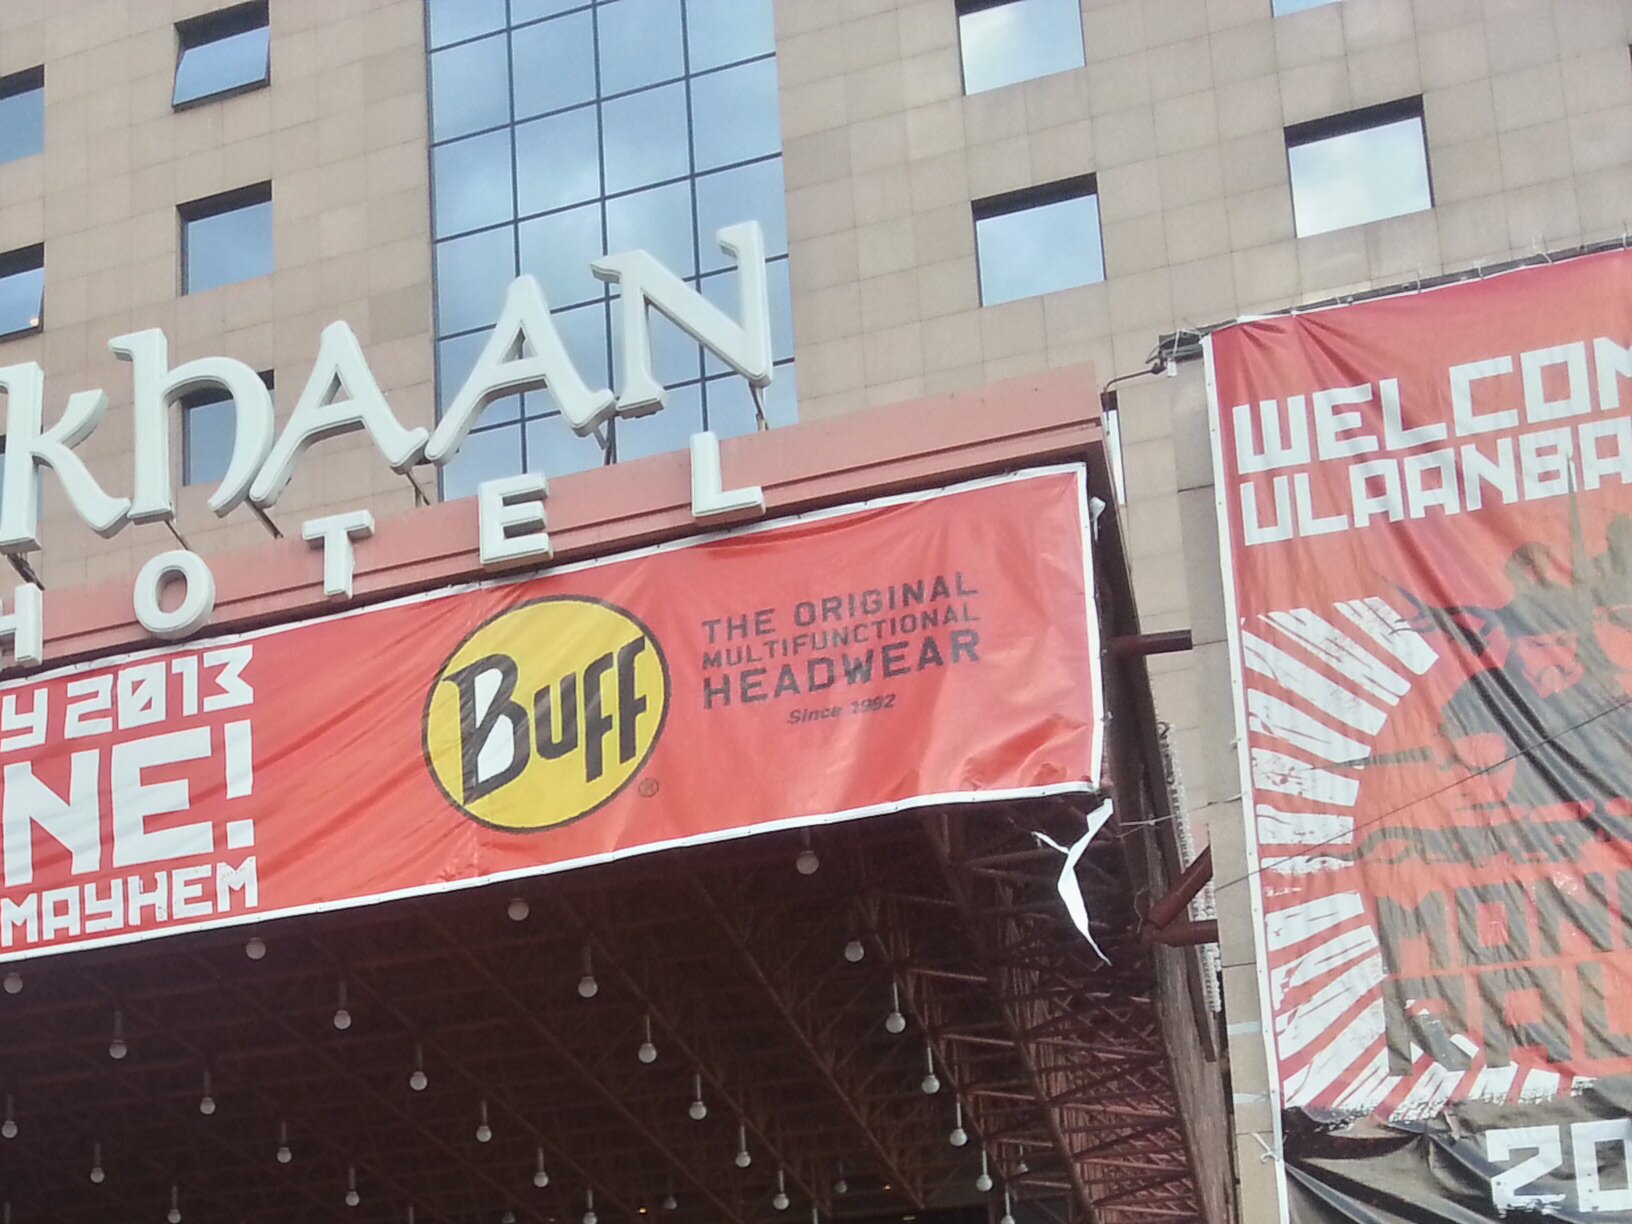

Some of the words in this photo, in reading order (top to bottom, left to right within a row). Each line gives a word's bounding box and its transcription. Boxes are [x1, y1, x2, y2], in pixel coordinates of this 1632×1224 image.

[702, 608, 775, 644] THE
[794, 571, 978, 627] ORIGINAL
[702, 601, 981, 670] MULTIFUNCTIONAL
[64, 644, 254, 739] 2013
[703, 629, 981, 710] HEADWEAR
[787, 704, 841, 725] Since
[0, 856, 258, 947] MAYHEM
[1378, 869, 1632, 975] MON
